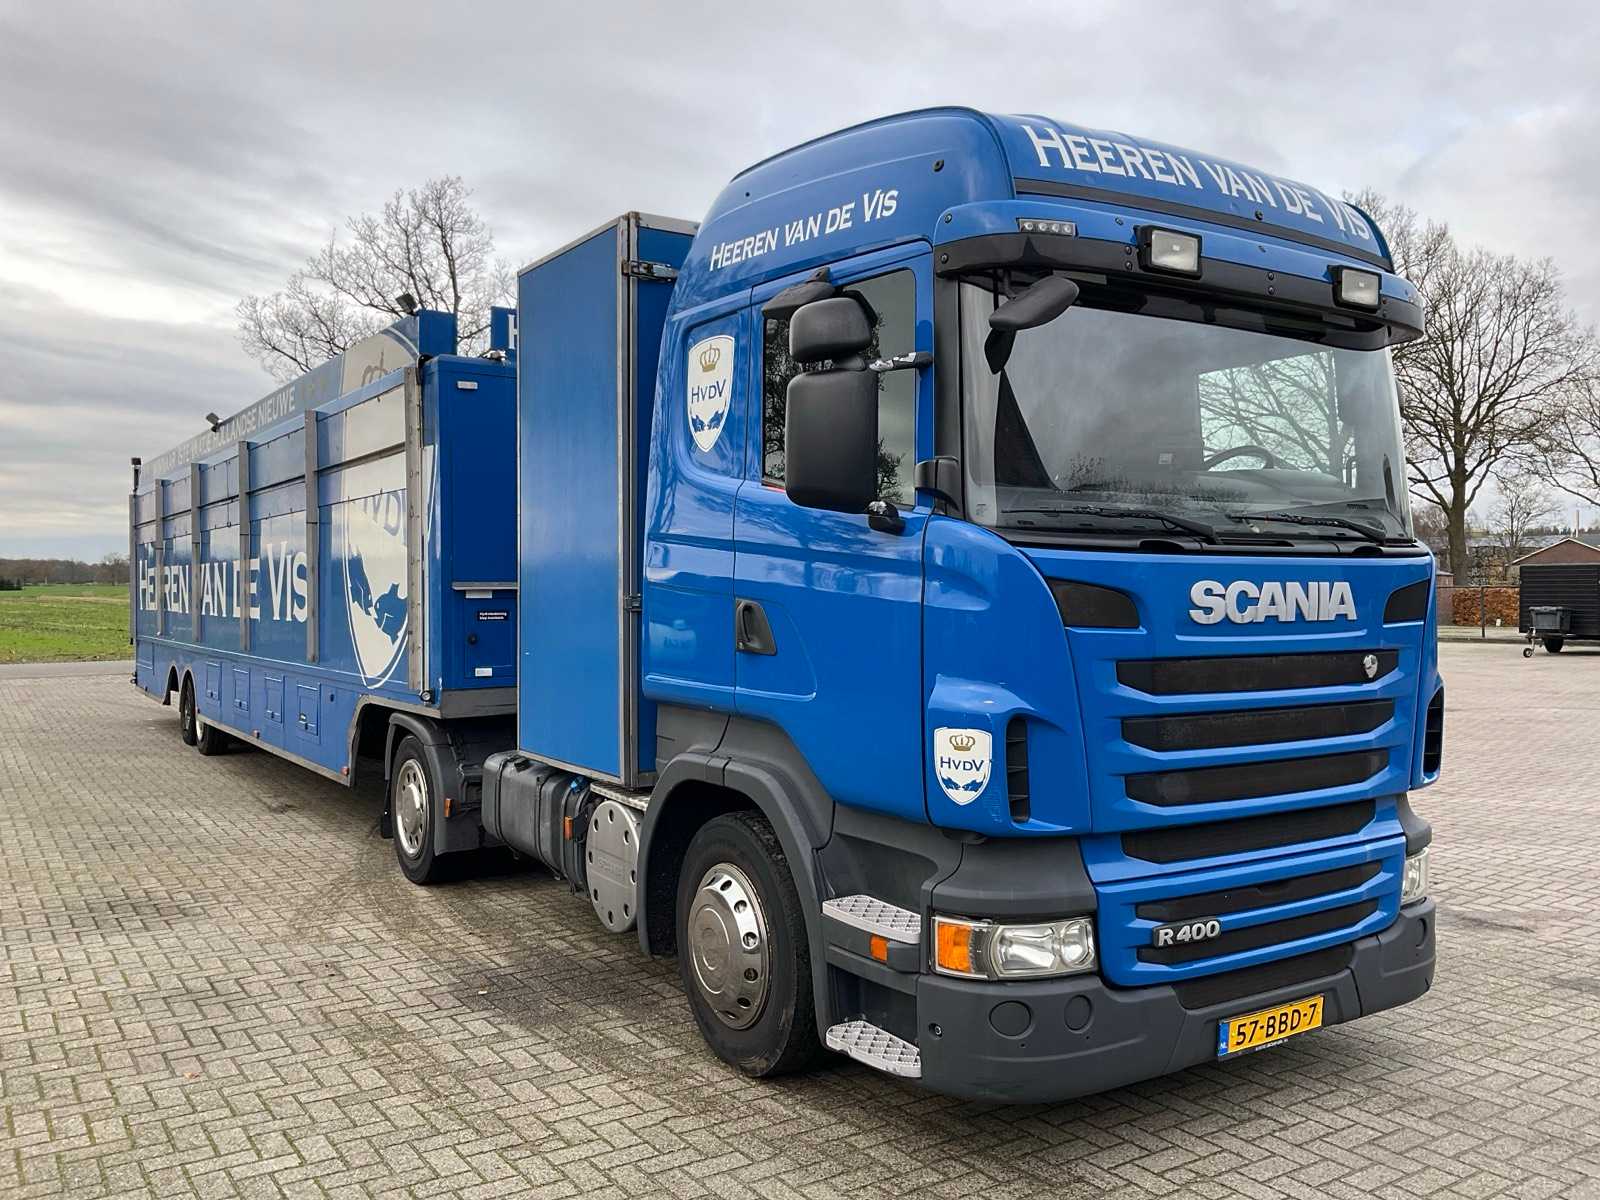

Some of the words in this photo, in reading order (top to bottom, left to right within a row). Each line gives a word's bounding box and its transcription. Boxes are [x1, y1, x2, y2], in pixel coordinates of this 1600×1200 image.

[1020, 125, 1203, 189] HEEREN
[1199, 160, 1277, 208] VAN
[1272, 180, 1324, 224] DE
[1314, 192, 1370, 240] VIS
[709, 227, 780, 272] HEEREN
[784, 213, 822, 247] VAN
[825, 201, 855, 235] DE
[863, 189, 899, 223] VIS
[258, 385, 296, 426] NIEUWE
[139, 559, 190, 614] HEREN
[266, 541, 308, 623] VIS
[1189, 580, 1358, 624] SCANIA
[1158, 928, 1174, 946] R
[1176, 920, 1220, 942] 400
[1236, 1003, 1318, 1045] 57-BBD-7
